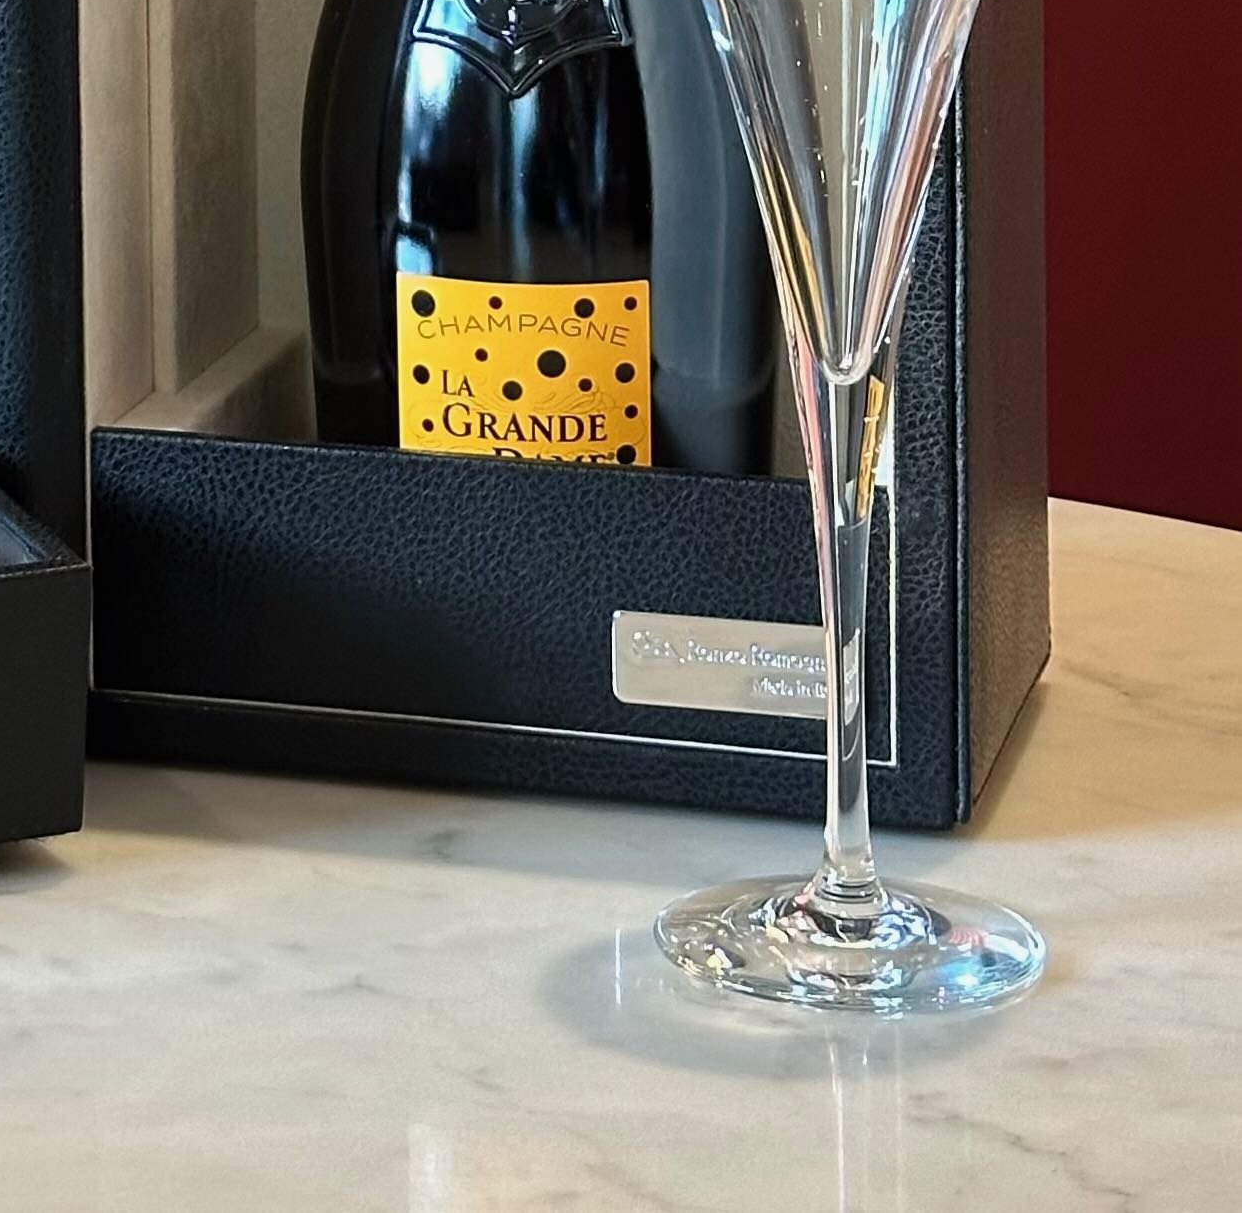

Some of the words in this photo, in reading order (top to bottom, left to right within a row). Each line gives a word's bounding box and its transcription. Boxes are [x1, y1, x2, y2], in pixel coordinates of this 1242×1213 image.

[417, 313, 631, 347] CHAMPAGNE
[441, 369, 475, 398] LA
[442, 402, 608, 443] GRANDE
